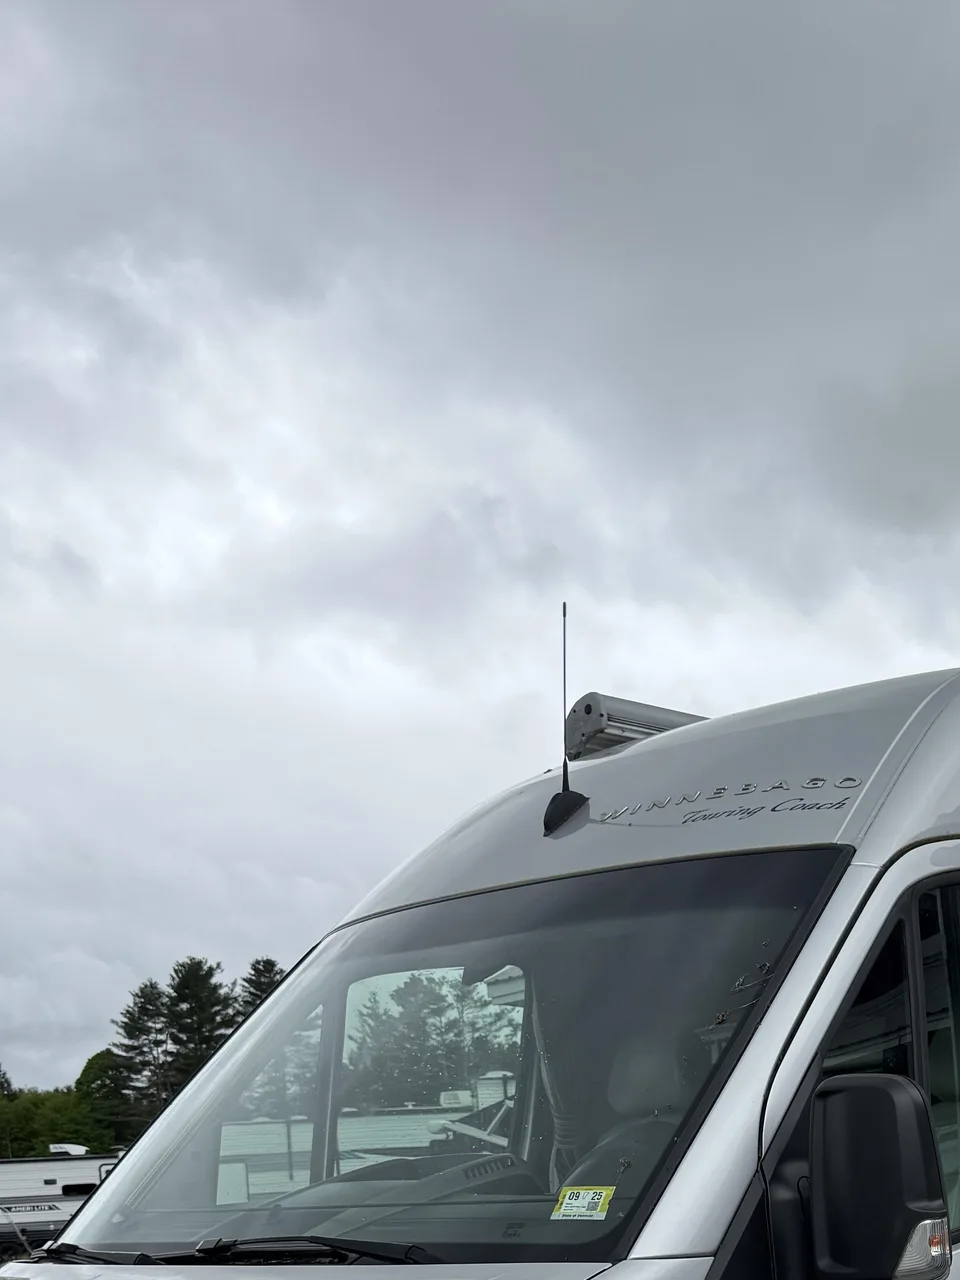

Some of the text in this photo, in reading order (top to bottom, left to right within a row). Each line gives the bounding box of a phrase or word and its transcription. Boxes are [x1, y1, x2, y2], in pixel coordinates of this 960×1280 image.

[600, 777, 862, 822] WINNEBAGO
[681, 796, 852, 825] Touring Coach
[568, 1191, 603, 1201] 09 25
